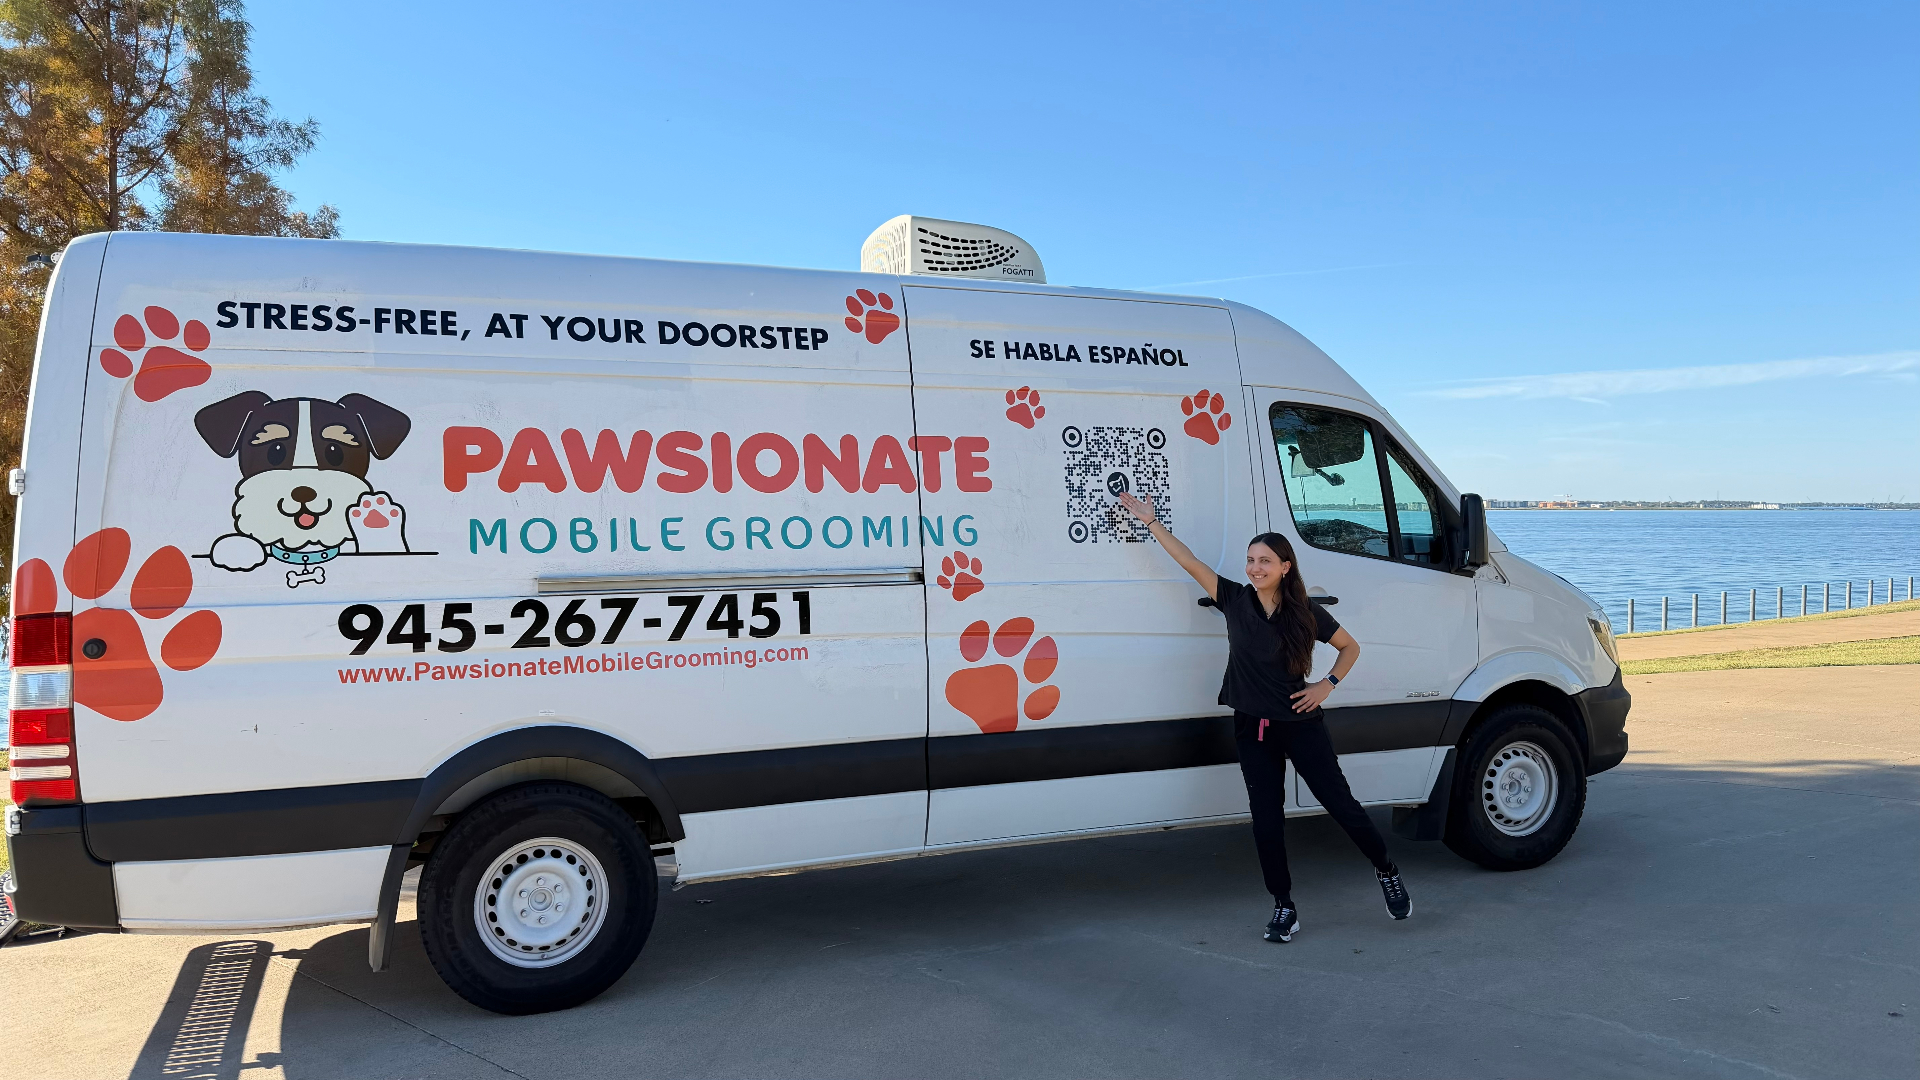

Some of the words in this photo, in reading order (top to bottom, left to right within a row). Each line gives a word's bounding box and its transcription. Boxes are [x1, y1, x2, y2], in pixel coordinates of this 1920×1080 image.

[1002, 267, 1034, 277] FOGATTI
[215, 300, 471, 341] STRESS-FREE,
[484, 312, 529, 339] AT
[540, 316, 647, 344] YOUR
[658, 321, 829, 351] DOORSTEP
[969, 339, 996, 359] SE
[1004, 342, 1082, 363] HABLA
[1088, 343, 1189, 367] ESPAÑOL
[442, 425, 993, 494] PAWSIONATE
[470, 516, 686, 555] MOBILE
[705, 514, 979, 551] GROOMING
[337, 591, 812, 656] 945-267-7451
[337, 645, 809, 684] www.PawsionateMobileGrooming.com
